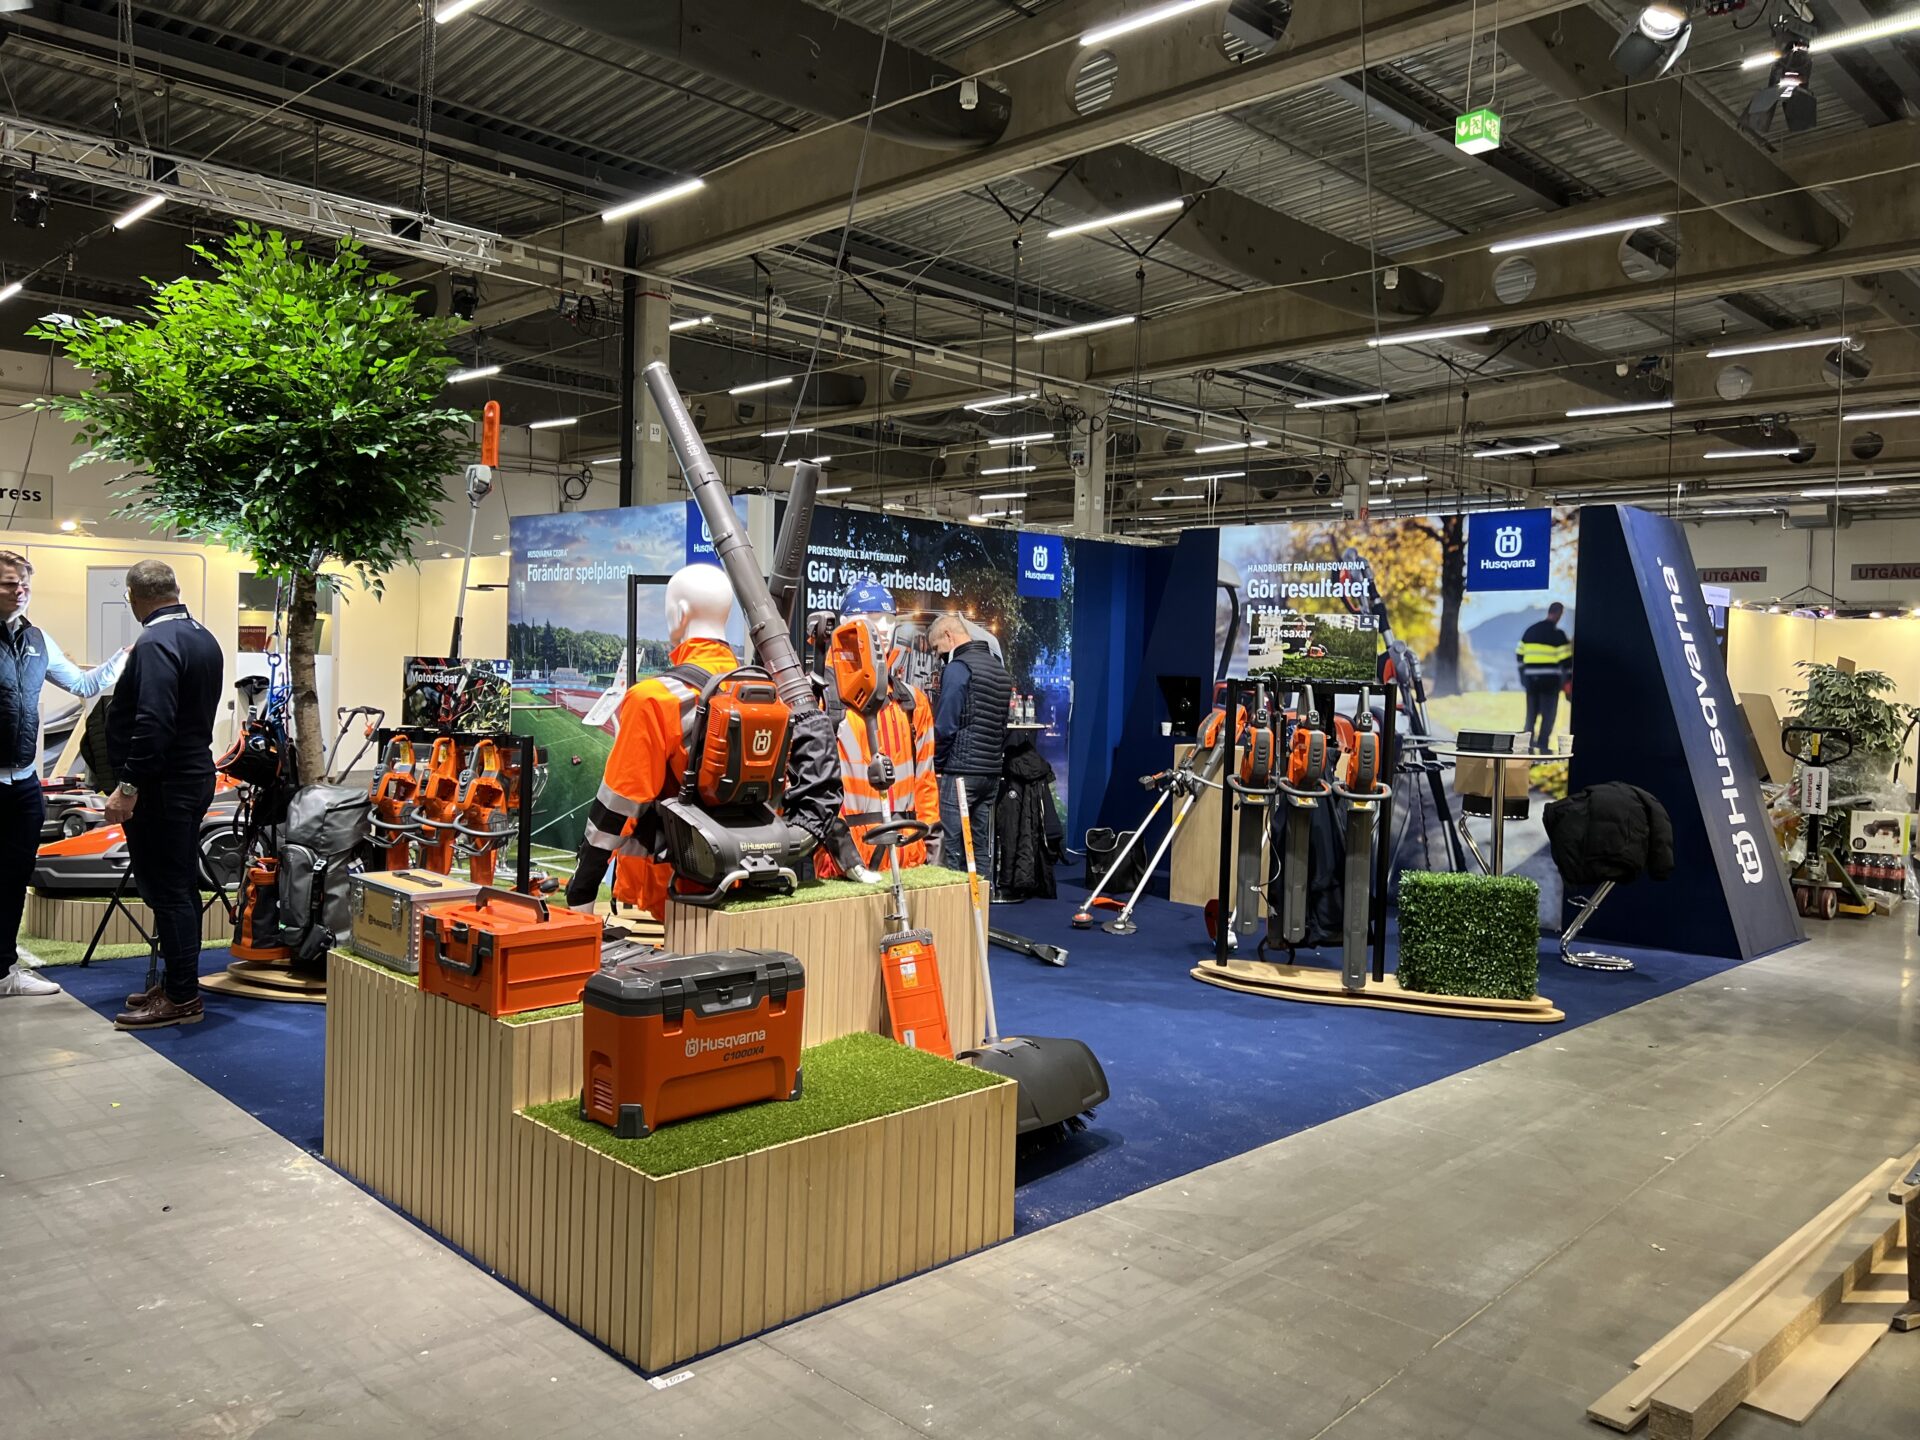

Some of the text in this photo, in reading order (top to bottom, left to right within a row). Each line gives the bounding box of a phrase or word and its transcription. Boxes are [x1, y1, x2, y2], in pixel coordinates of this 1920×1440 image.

[807, 545, 907, 564] PROFESSIONELL BATTERIKRAFT
[527, 561, 633, 585] Förändrar spelplanen
[1248, 561, 1366, 573] HANDBURET FRÅN HUSQVARNA
[1481, 559, 1536, 570] Husqvarna
[807, 560, 836, 583] Gör
[881, 569, 951, 597] arbetsdag
[1025, 570, 1055, 581] Husqvarna
[1703, 567, 1760, 582] UTGÅNG
[1247, 578, 1370, 598] Gör resultatet
[410, 671, 459, 687] Motorsågar
[1662, 565, 1746, 825] Husqvarna
[700, 1029, 766, 1053] Husqvarna
[723, 1045, 765, 1062] C1000X4
